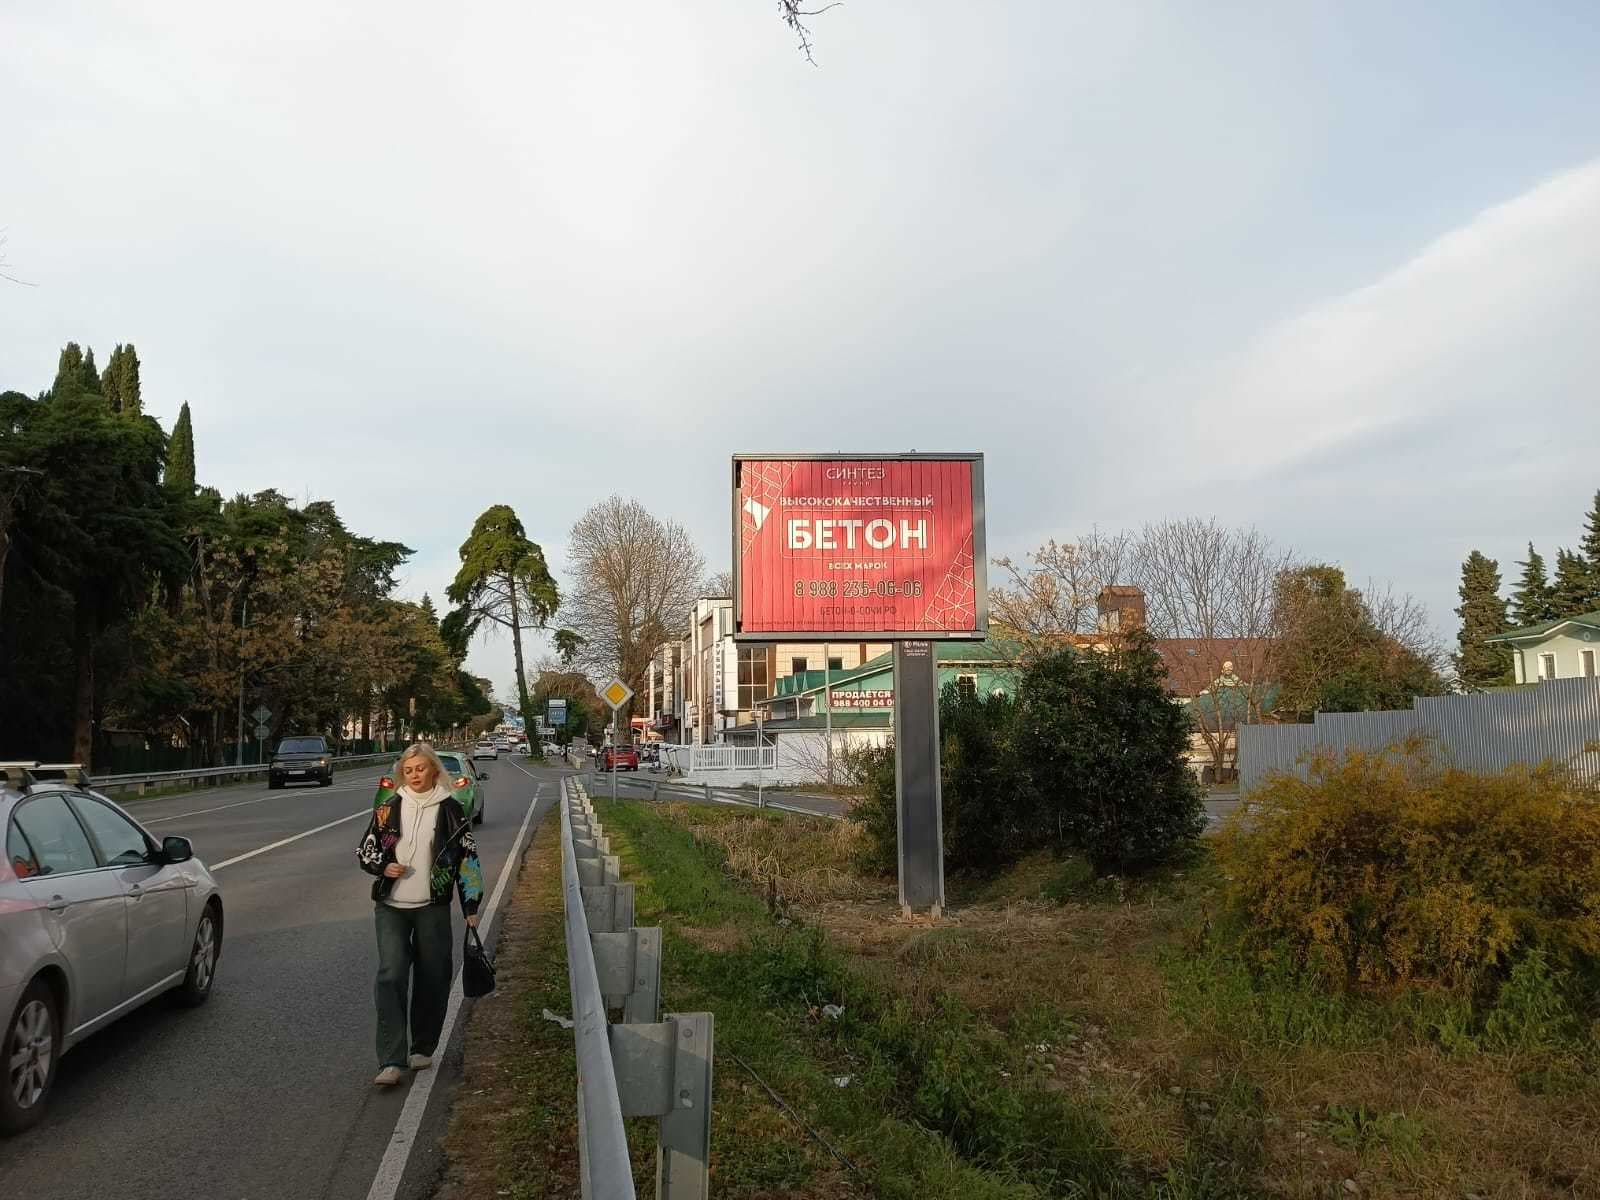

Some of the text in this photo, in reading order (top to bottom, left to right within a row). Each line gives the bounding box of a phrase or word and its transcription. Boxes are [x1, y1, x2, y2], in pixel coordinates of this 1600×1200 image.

[826, 467, 886, 480] СИНТЕЗ
[780, 494, 934, 507] ВЫСОКОКАЧЕСТВЕННЫЙ
[787, 518, 928, 550] БЕТОН
[794, 580, 804, 597] 8
[809, 580, 838, 597] 988
[853, 699, 870, 707] 400
